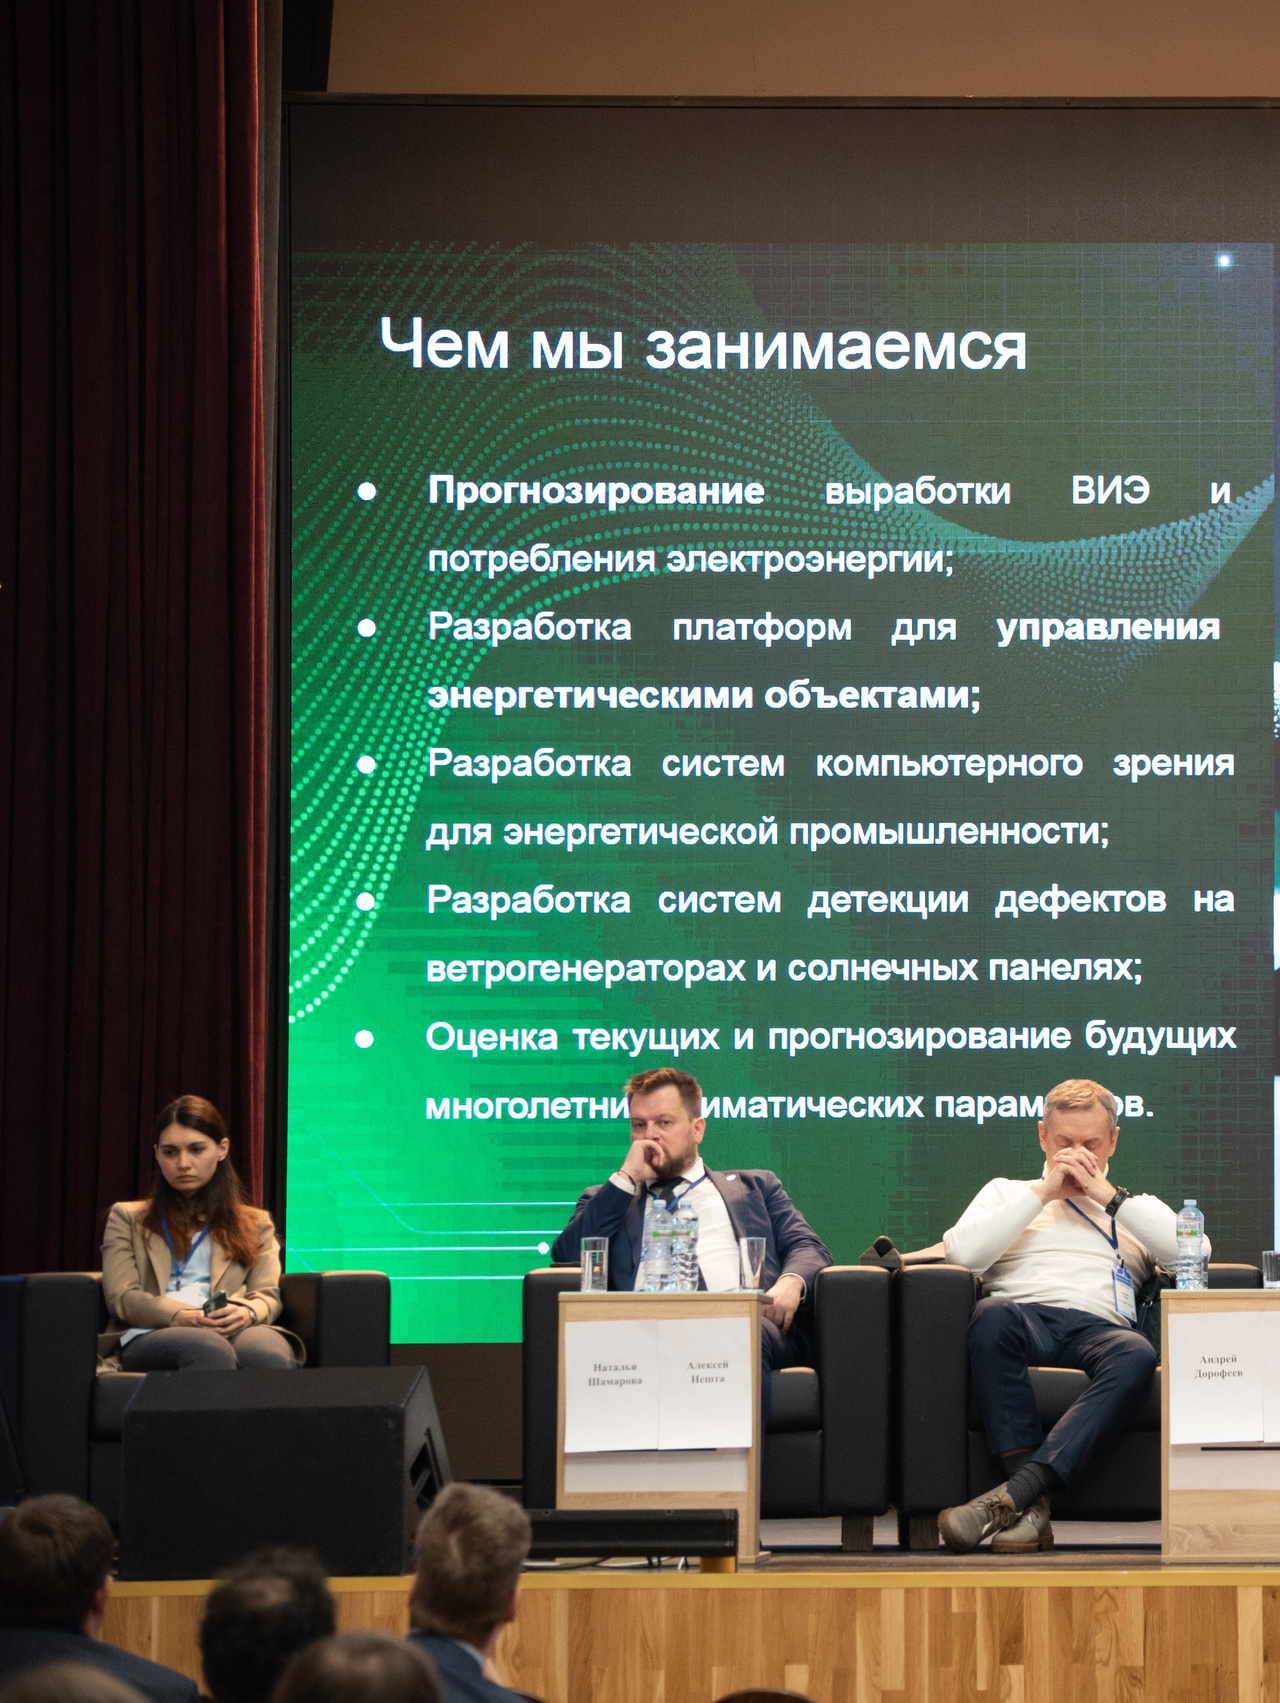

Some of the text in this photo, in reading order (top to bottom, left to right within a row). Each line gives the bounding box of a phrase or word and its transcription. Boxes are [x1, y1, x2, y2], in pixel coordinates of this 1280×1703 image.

[382, 317, 1025, 370] Чем мы занимаемся
[429, 475, 1230, 511] Прогнозирование выработки ВИЭ и
[429, 543, 952, 579] потребления электроэнергии;
[429, 611, 1220, 648] Разработка платформ для управления
[428, 678, 980, 716] энергетическими объектами;
[429, 747, 1235, 784] Разработка систем компьютерного зрения
[426, 815, 1109, 852] для энергетической промышленности;
[428, 883, 1235, 921] Разработка систем детекции дефектов на
[427, 959, 1142, 990] ветрогенераторах и солнечных панелях;
[426, 1019, 1237, 1058] Оценка текущих и прогнозирование будущих
[426, 1097, 630, 1120] многолетни
[700, 1096, 925, 1120] иматических
[593, 1363, 637, 1372] Наталья
[687, 1360, 729, 1370] Алексей
[1194, 1368, 1244, 1379] Дорофеев
[1199, 1354, 1238, 1366] Андрей
[588, 1377, 643, 1388] Шамарова
[691, 1374, 725, 1384] Нешта
